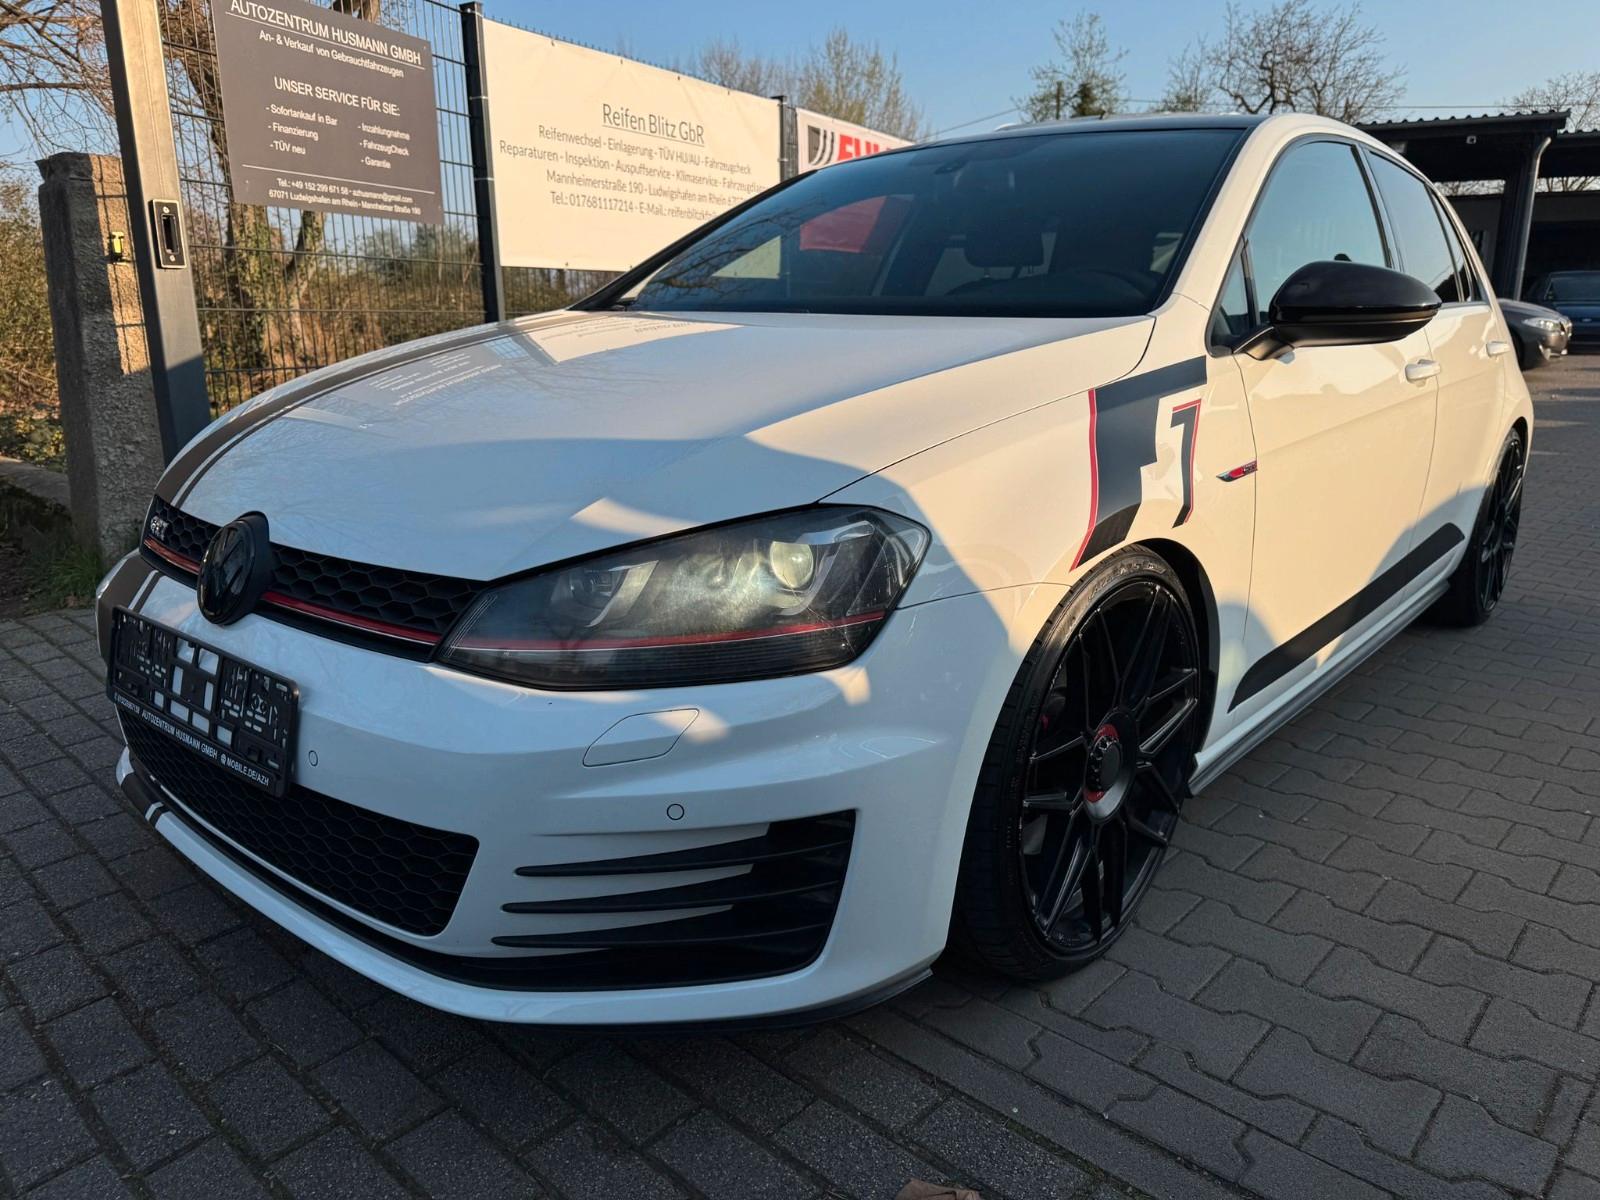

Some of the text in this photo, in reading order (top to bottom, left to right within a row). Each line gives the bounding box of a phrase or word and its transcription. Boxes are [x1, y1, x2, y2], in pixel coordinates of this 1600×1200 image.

[230, 0, 421, 65] AUTOZENTRUM HUSMANN GMBH
[260, 30, 274, 42] An-
[284, 37, 314, 53] Verkauf
[316, 48, 330, 58] von
[332, 50, 404, 78] Gebrauchtfahrzeugen
[274, 77, 400, 116] UNSER SERVICE FÜR SIE:
[270, 104, 316, 121] Sofortankauf
[317, 113, 324, 123] in
[325, 115, 338, 126] Bar
[602, 104, 704, 144] Reifen Blitz GbR
[272, 122, 319, 141] Finanzierung
[362, 122, 410, 140] Inzahlungnahme
[273, 140, 290, 152] TÜV
[292, 146, 306, 155] neu
[363, 139, 410, 156] FahrzeugCheck
[538, 124, 601, 148] Reifenwechsel
[608, 138, 653, 160] Einlagerung
[659, 146, 675, 160] TÜV
[705, 156, 751, 174] Fahrzeugcheck
[365, 156, 391, 168] Garantie
[500, 140, 558, 162] Reparaturen
[565, 152, 609, 170] Inspektion
[616, 160, 671, 180] Auspuffservice
[676, 170, 718, 187] Klimaservice
[269, 189, 288, 199] 67071
[290, 192, 331, 204] Ludwigshafen
[292, 180, 303, 189] +49
[304, 182, 316, 191] 152
[546, 169, 627, 192] Mannheimerstraße
[628, 181, 644, 194] 190
[648, 184, 696, 201] Ludwigshafen
[698, 194, 707, 203] am
[142, 710, 269, 786] AUTOZENTRUM HUSMANN GMBH MOBILE.DE/AZH
